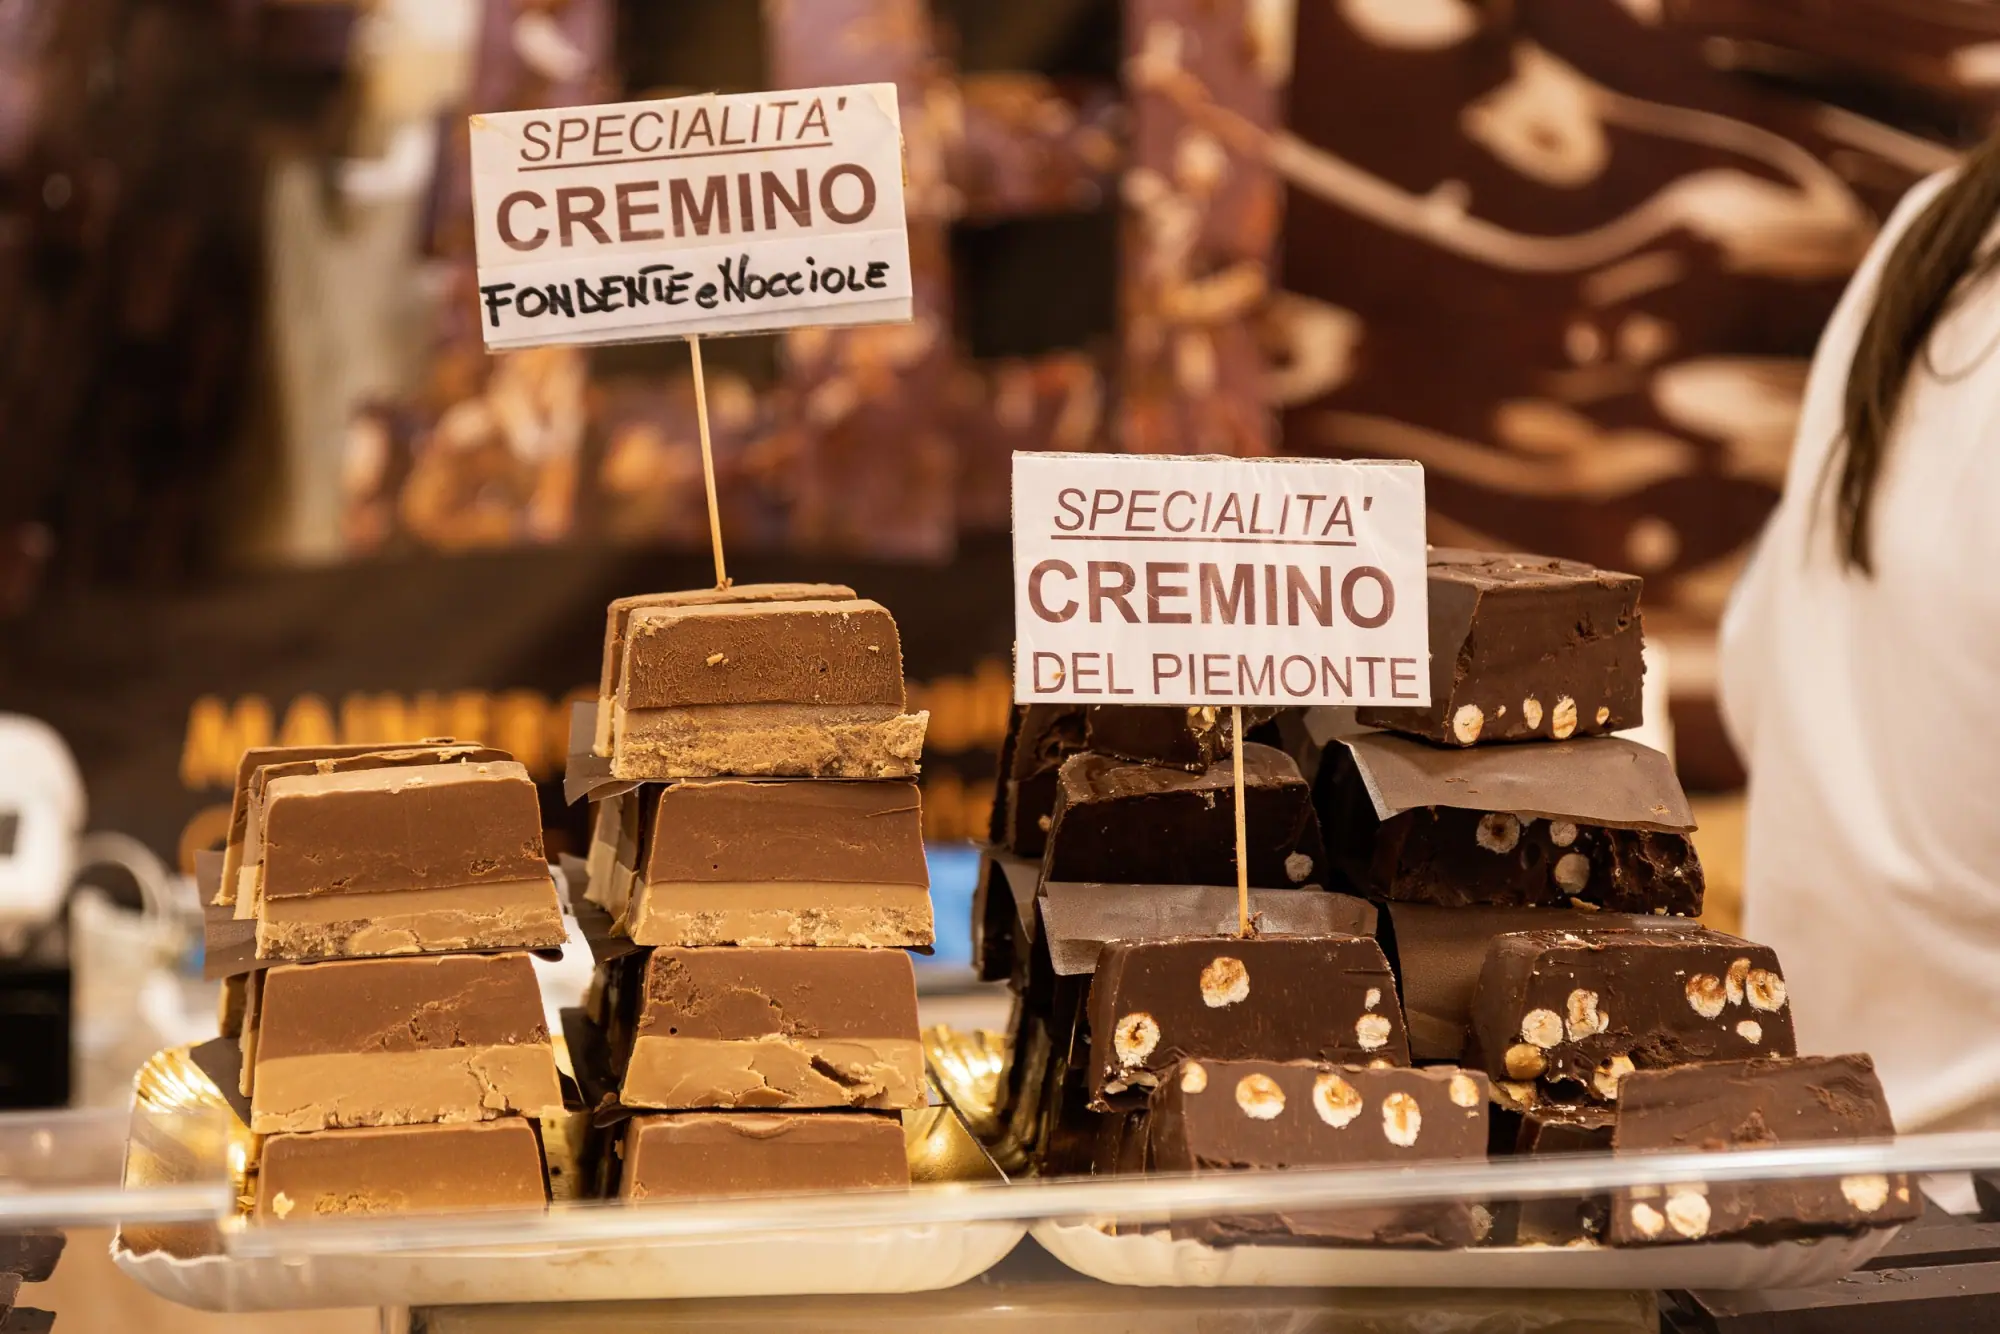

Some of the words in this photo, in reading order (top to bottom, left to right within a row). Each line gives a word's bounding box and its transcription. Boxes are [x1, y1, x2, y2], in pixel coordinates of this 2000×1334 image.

[519, 96, 848, 162] SPECIALITA'
[496, 163, 877, 252] CREMINO
[480, 264, 693, 327] FONDENTE
[695, 282, 719, 309] e
[1053, 487, 1373, 537] SPECIALITA'
[1028, 559, 1396, 629] CREMINO
[1032, 651, 1134, 694] DEL
[1152, 652, 1419, 699] PIEMONTE
